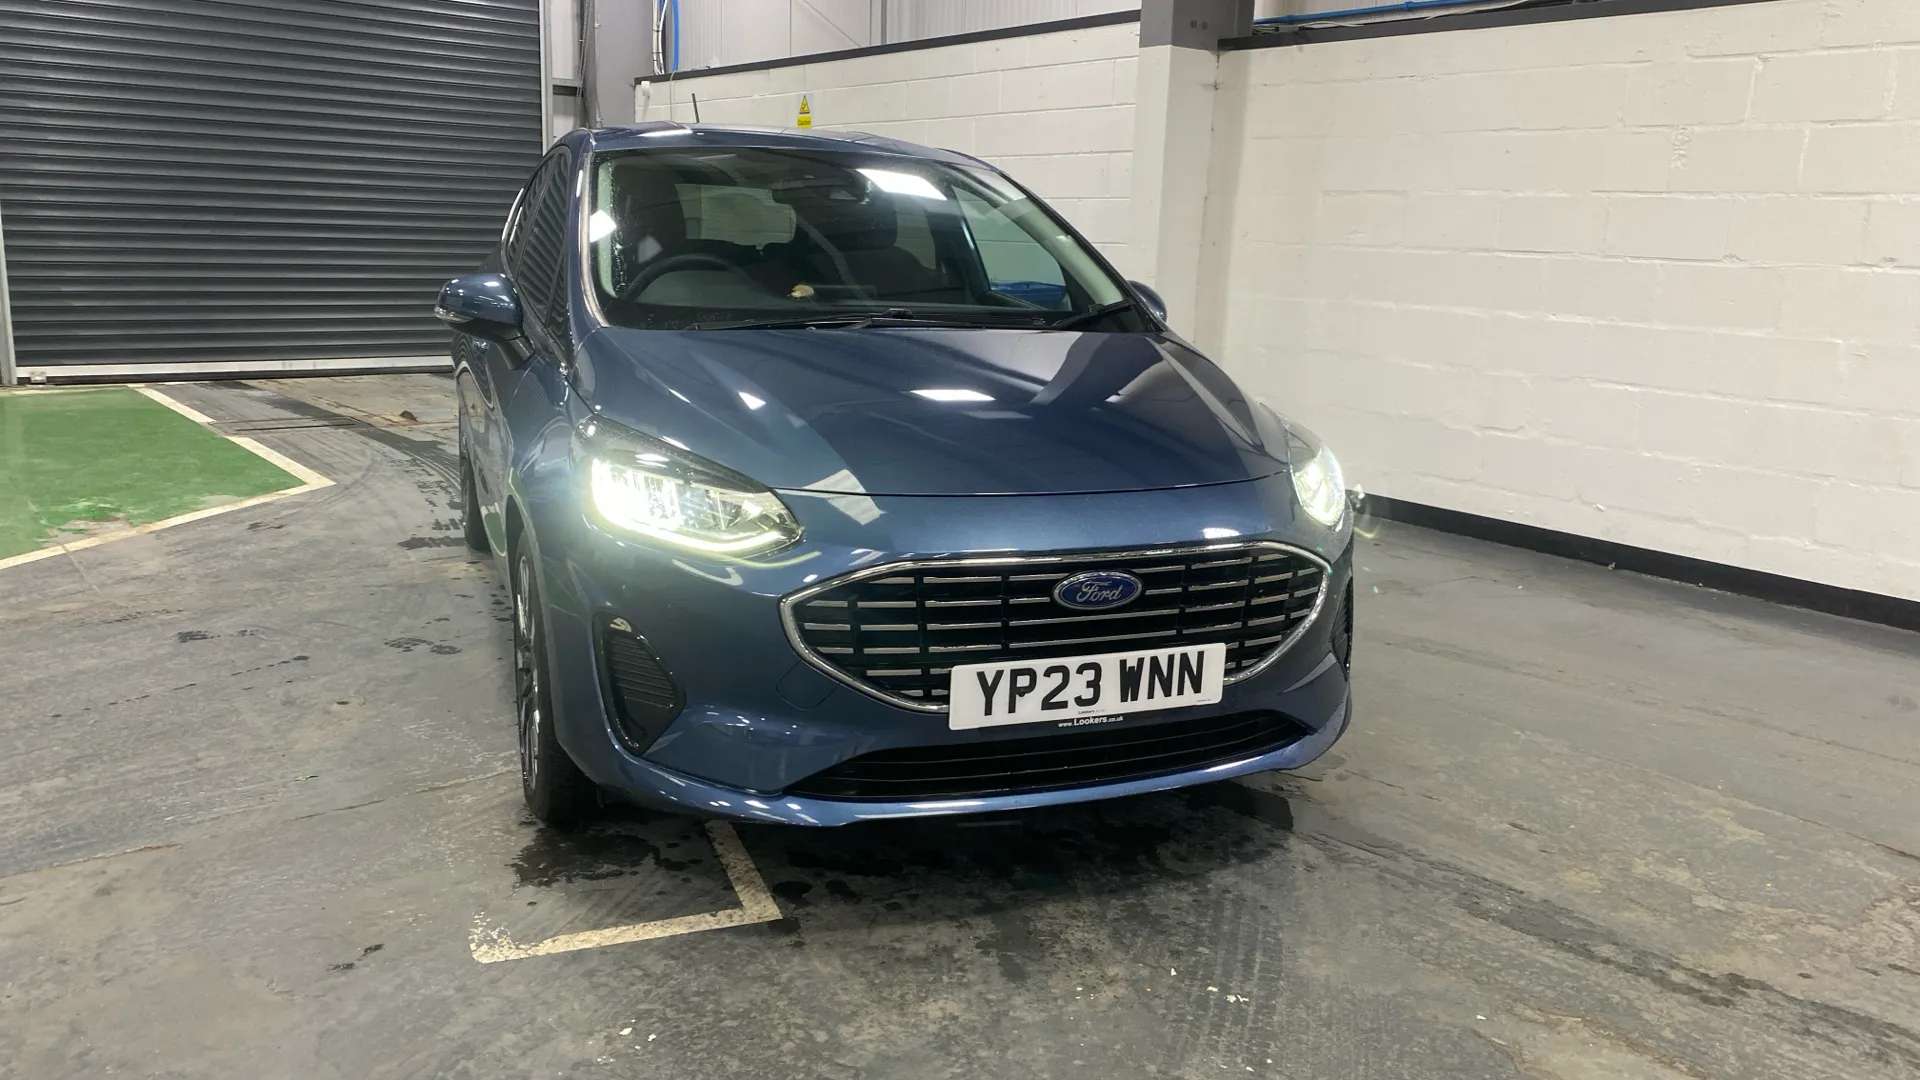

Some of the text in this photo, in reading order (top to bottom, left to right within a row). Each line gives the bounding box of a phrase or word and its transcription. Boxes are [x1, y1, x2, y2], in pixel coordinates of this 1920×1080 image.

[1076, 581, 1123, 602] Ford
[976, 651, 1205, 716] YP23 WNN
